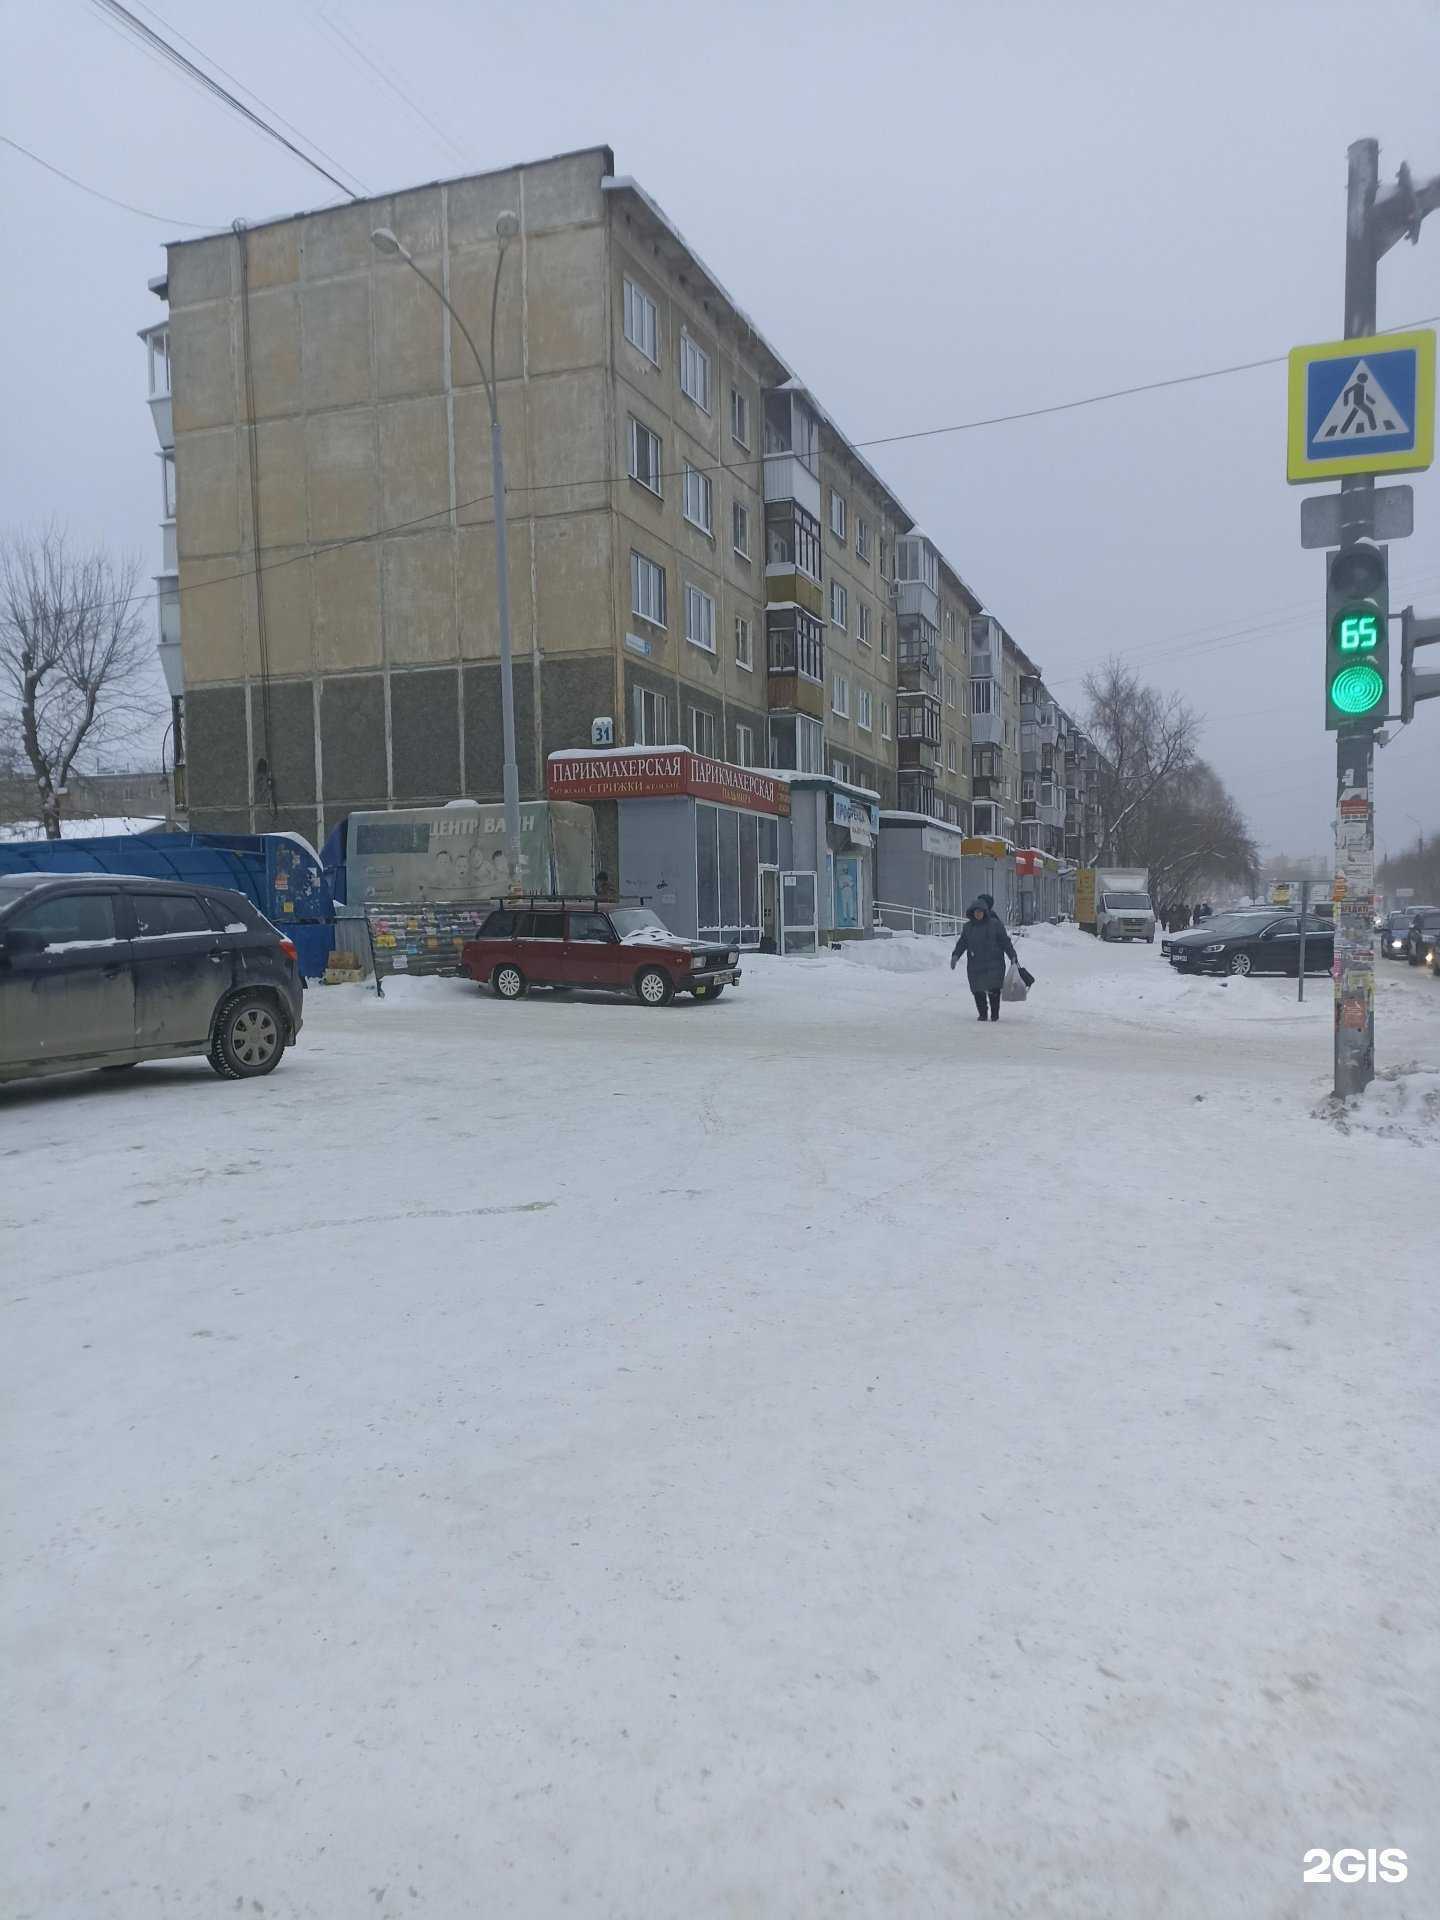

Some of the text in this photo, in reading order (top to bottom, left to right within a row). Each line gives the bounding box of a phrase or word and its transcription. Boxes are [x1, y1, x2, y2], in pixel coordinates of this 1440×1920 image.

[1341, 617, 1377, 649] 65
[596, 726, 610, 741] 31
[553, 757, 681, 783] ПАРИКМАХЕРСКАЯ
[690, 759, 775, 803] ПАРИКМАХЕРСКАЯ
[589, 780, 643, 793] СТРИЖКИ
[484, 815, 535, 833] ВАН
